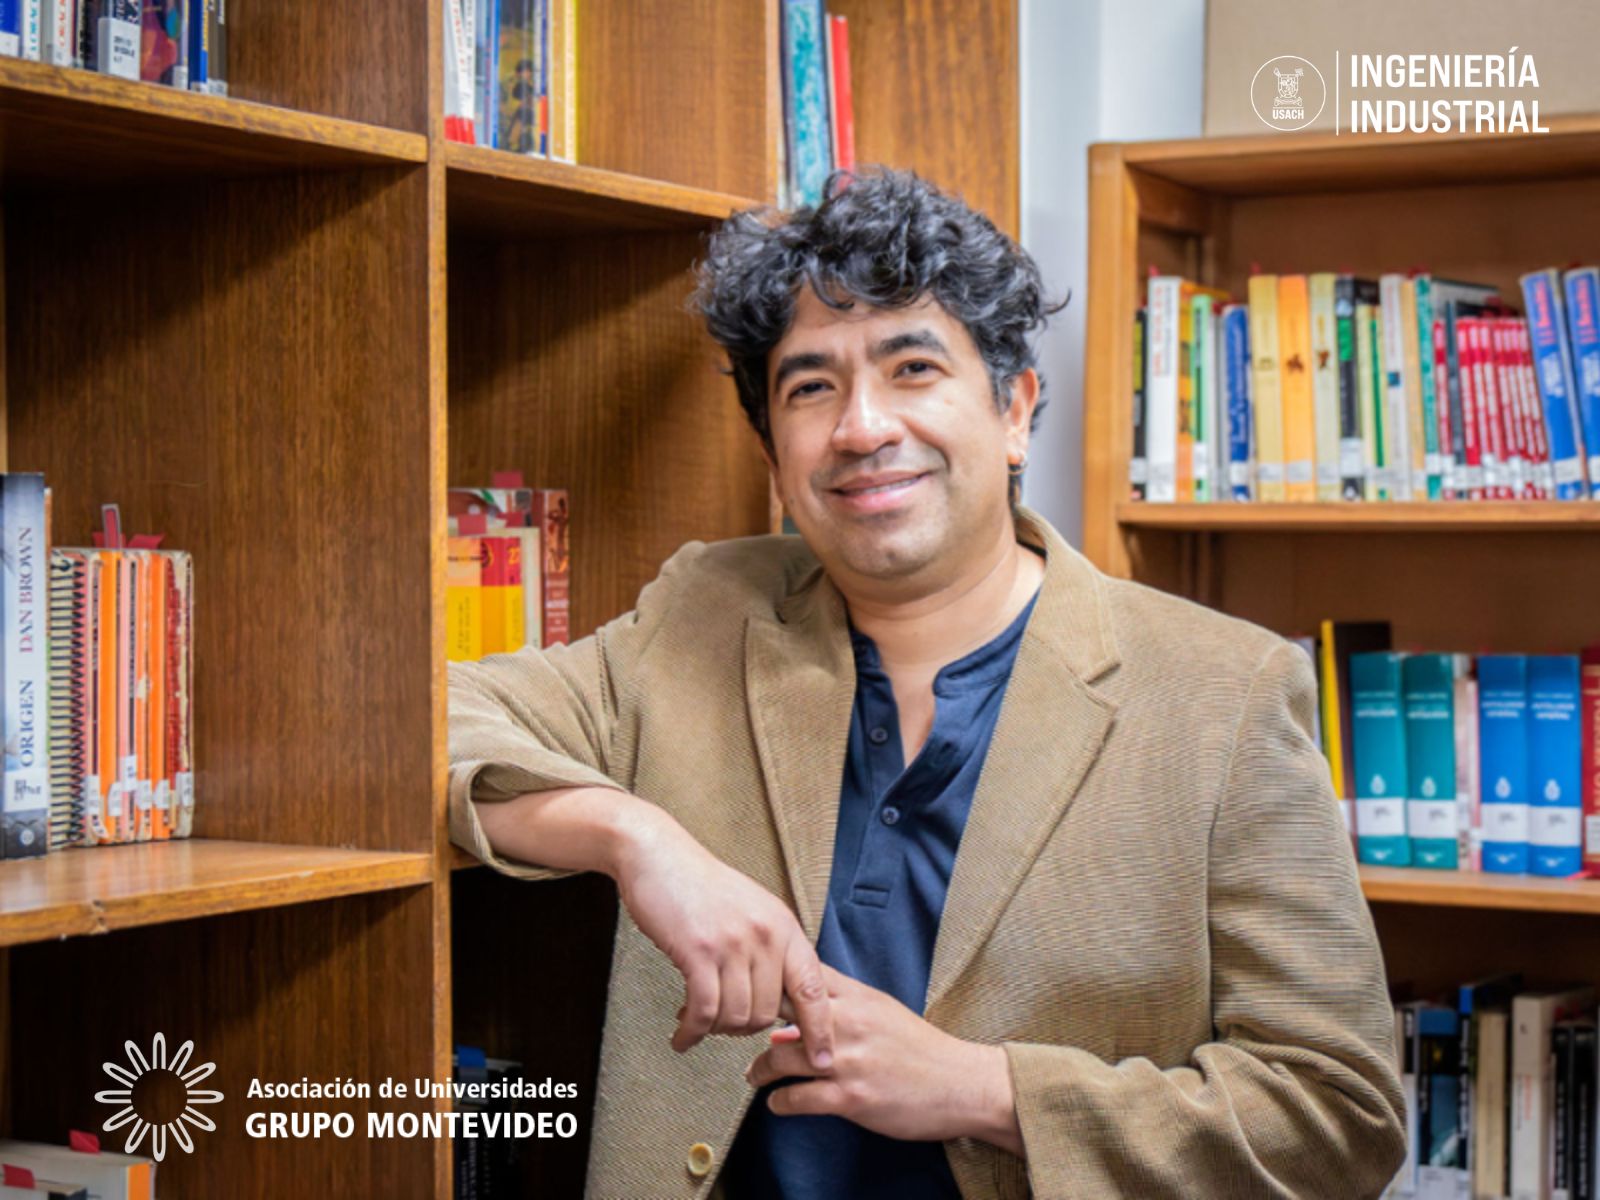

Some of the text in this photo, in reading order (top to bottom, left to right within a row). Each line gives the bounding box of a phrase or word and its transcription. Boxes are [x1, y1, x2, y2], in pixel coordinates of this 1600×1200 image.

[19, 527, 33, 603] BROWN
[19, 610, 33, 653] DAN
[19, 680, 34, 768] ORIGEN
